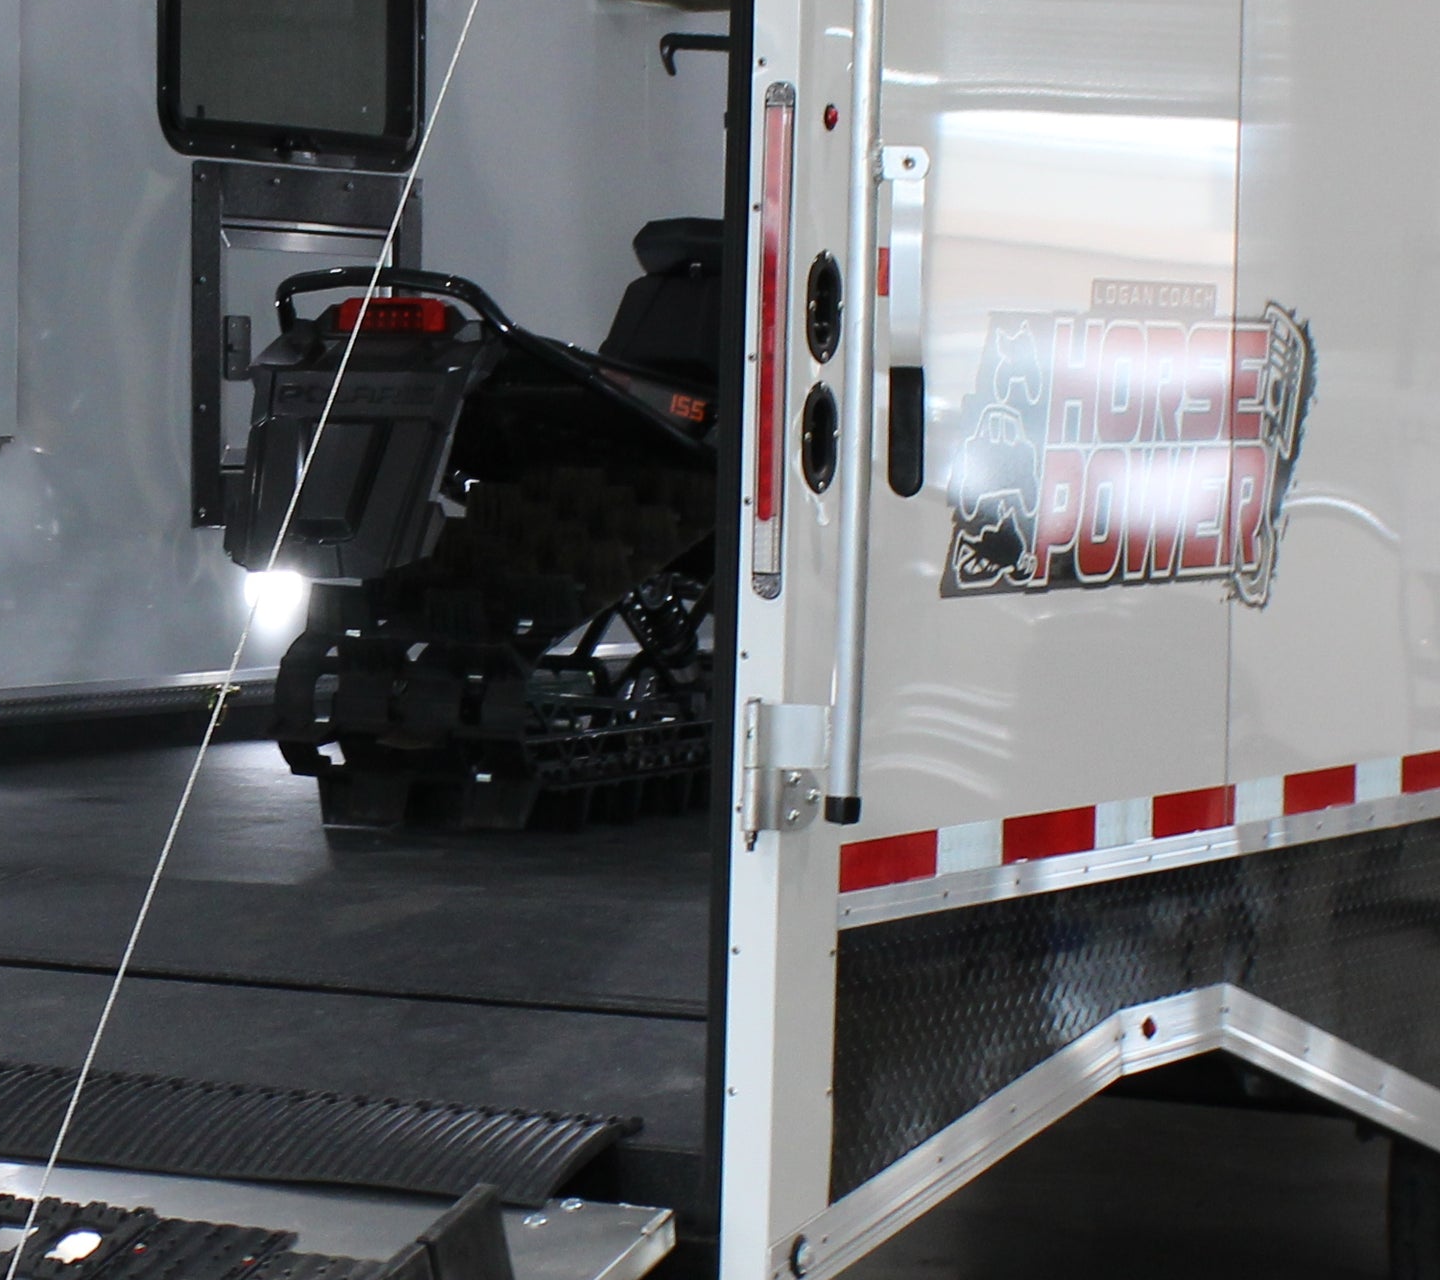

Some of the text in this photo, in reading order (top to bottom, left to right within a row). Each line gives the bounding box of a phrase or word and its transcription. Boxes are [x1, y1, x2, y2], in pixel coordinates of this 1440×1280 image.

[1093, 282, 1153, 307] LOGAN
[1048, 318, 1272, 445] HORSE
[1027, 442, 1270, 587] POWER
